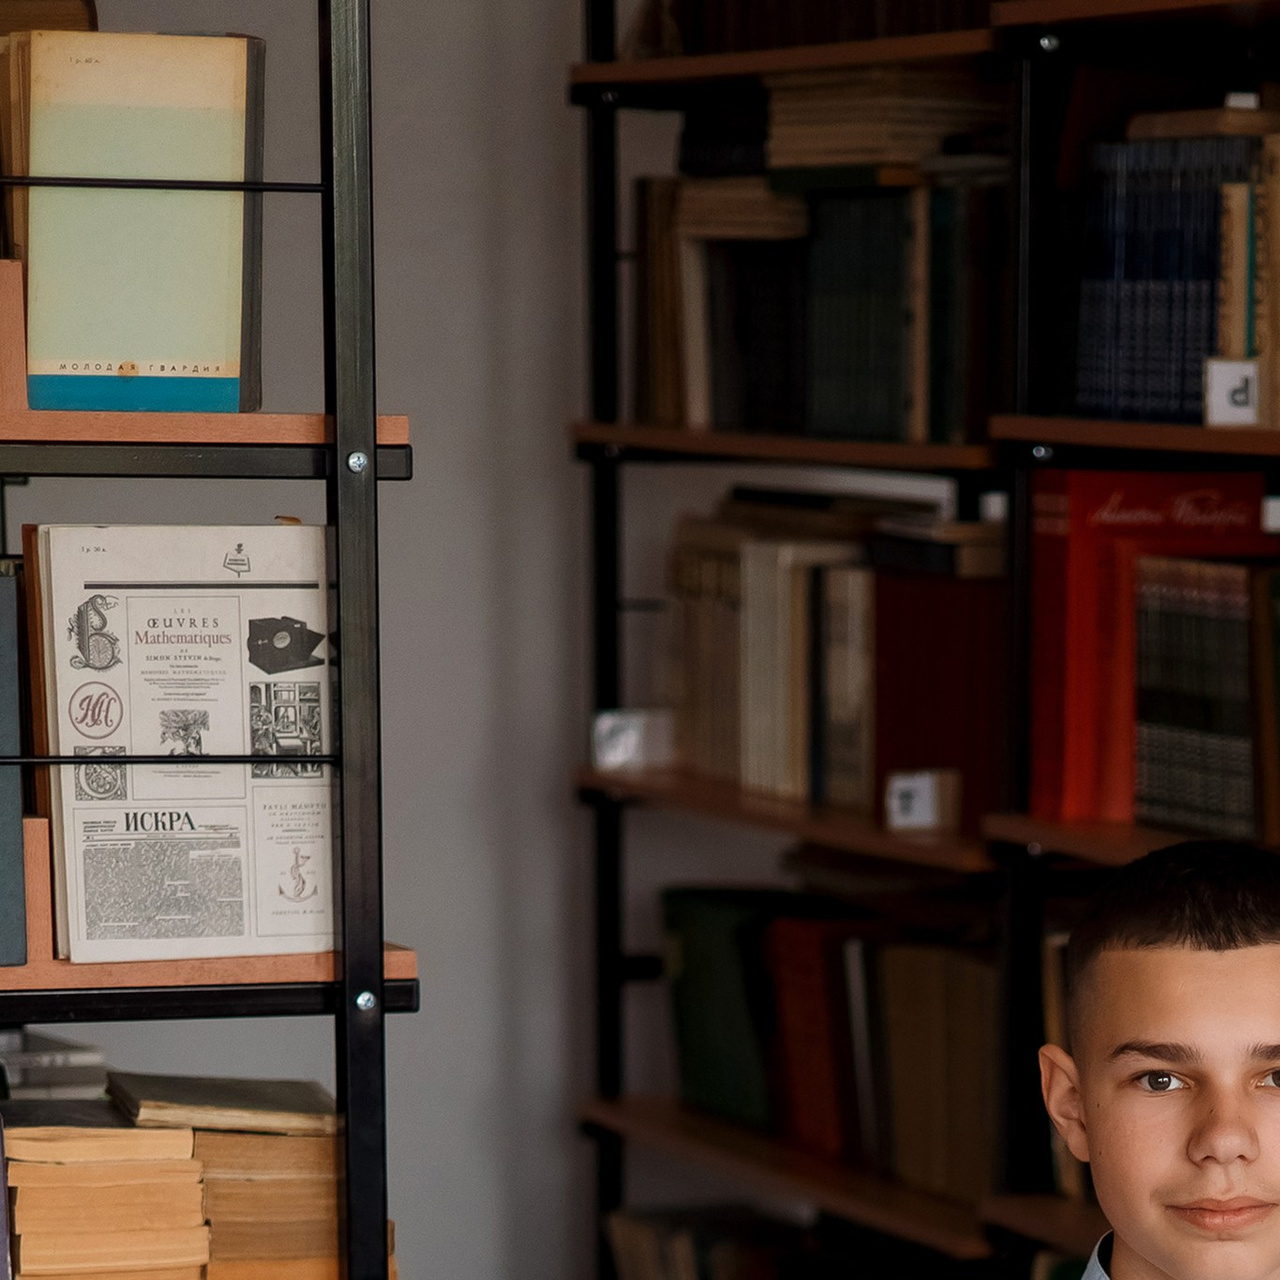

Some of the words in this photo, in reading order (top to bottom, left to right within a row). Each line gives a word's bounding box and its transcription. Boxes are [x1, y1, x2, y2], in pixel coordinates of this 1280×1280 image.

[59, 362, 136, 371] МОЛОДАЯ
[149, 364, 220, 374] ГВАРДИЯ
[135, 630, 232, 648] Mathematiques
[124, 811, 196, 832] ИСКРА
